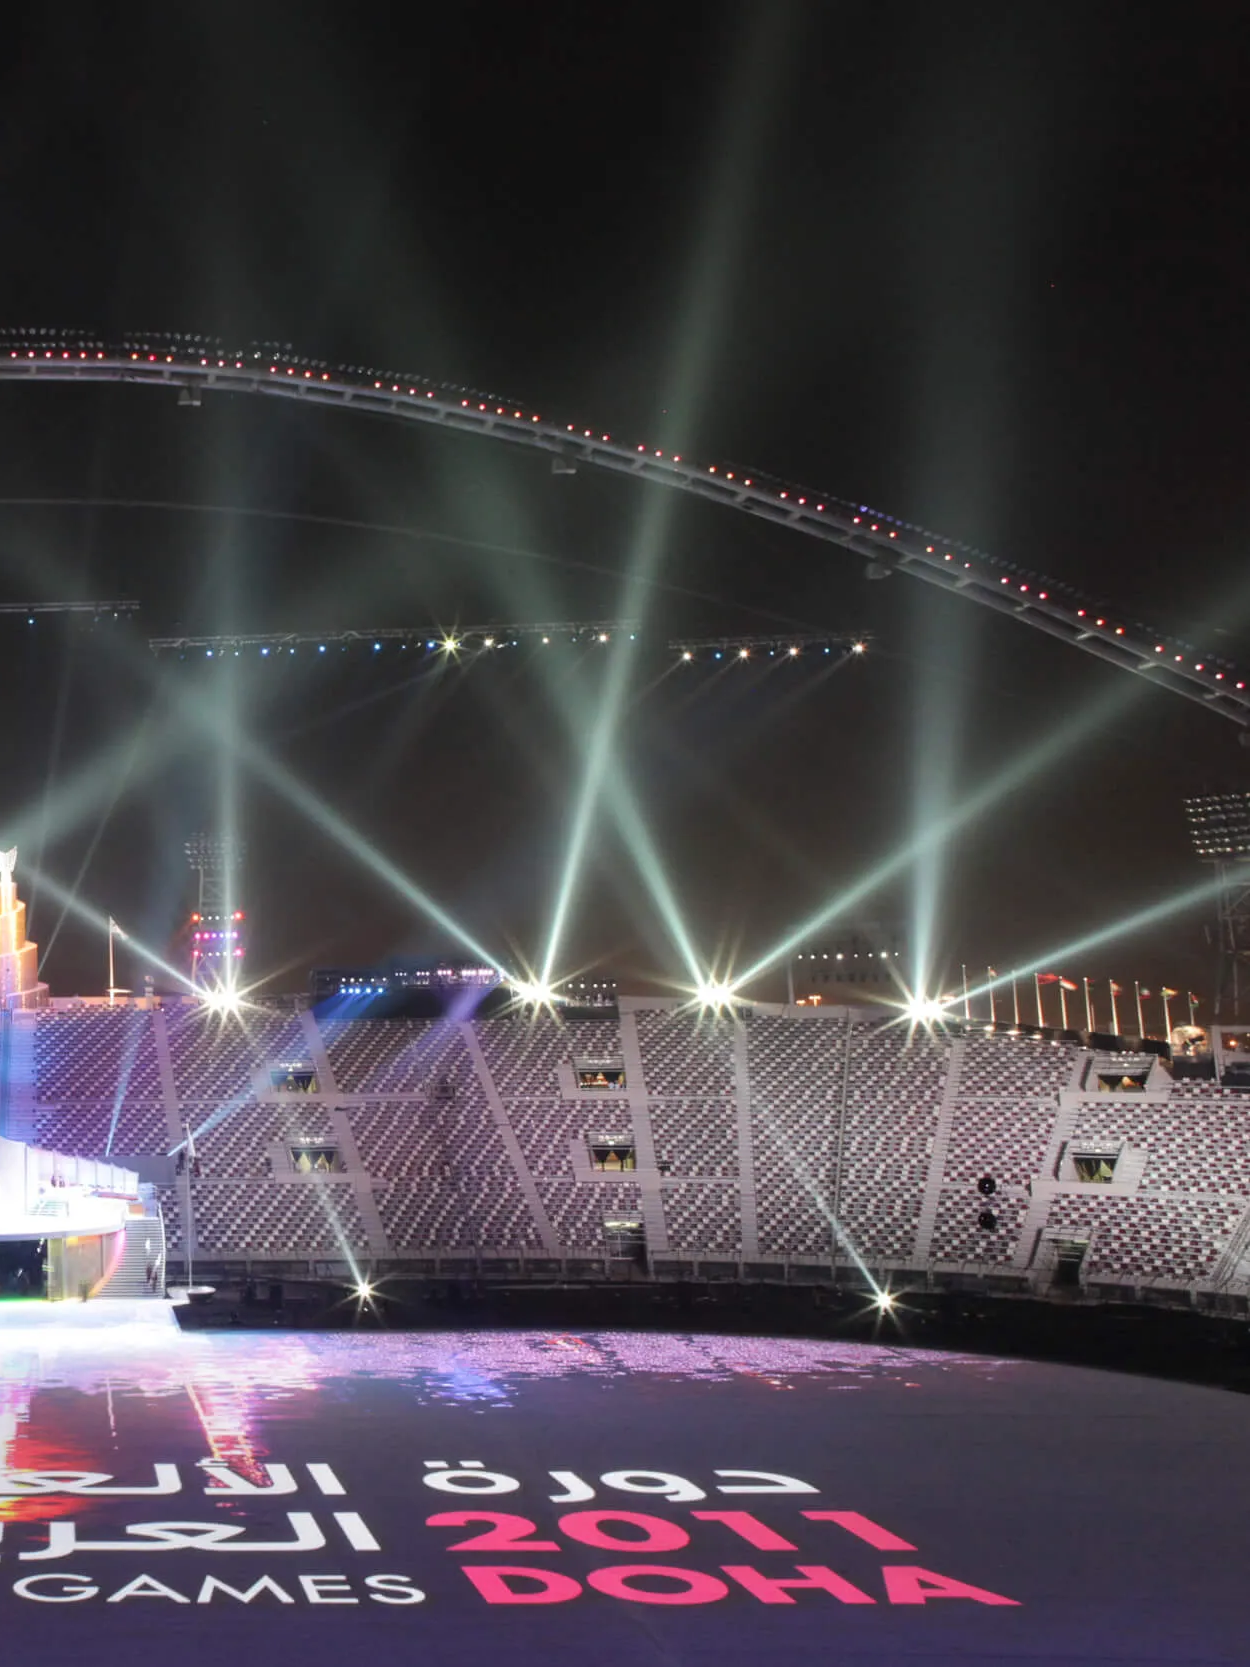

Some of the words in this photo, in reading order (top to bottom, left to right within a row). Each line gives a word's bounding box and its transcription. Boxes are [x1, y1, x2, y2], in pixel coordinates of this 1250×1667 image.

[422, 1460, 821, 1502] دورة
[425, 1510, 919, 1552] 2011
[12, 1573, 427, 1605] GAMES
[461, 1564, 1023, 1606] DOHA
